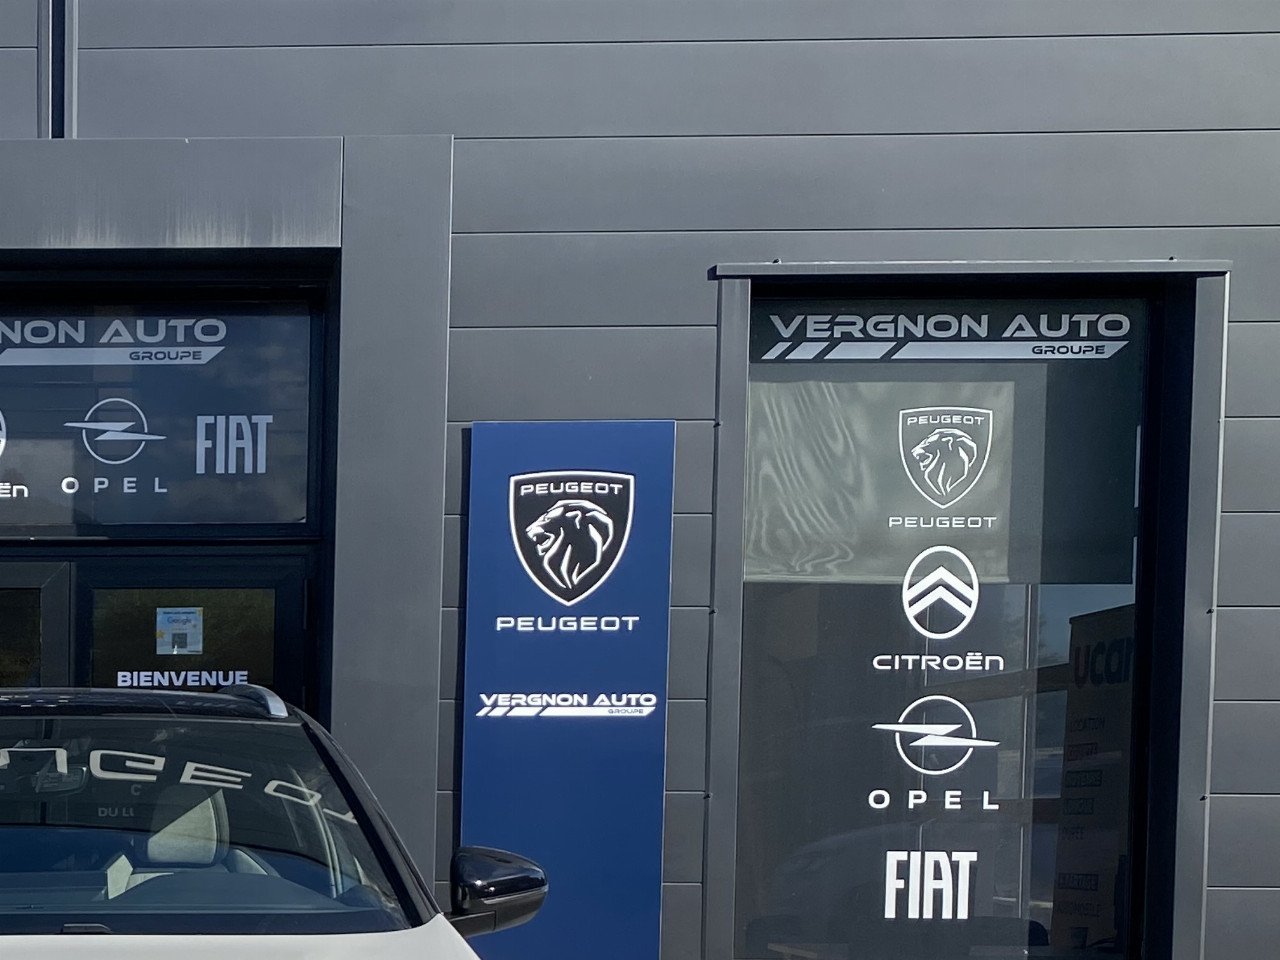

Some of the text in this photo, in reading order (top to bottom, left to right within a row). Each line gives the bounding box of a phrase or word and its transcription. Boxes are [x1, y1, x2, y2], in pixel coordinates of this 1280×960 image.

[99, 319, 227, 343] AUTO
[769, 313, 1131, 338] VERGNON AUTO
[129, 351, 203, 362] GROUPE
[1031, 345, 1106, 356] GROUPE
[907, 414, 985, 426] PEUGEOT
[195, 415, 274, 474] FIAT
[61, 476, 168, 494] OPEL
[520, 482, 624, 496] PEUGEOT
[888, 516, 997, 528] PEUGEOT
[167, 616, 193, 626] Google
[496, 616, 640, 631] PEUGEOT
[872, 651, 1004, 671] CITROËN
[117, 670, 249, 687] BIENVENUE
[479, 693, 657, 706] VERGNON AUTO
[868, 789, 999, 810] OPEL
[883, 850, 978, 919] FIAT
